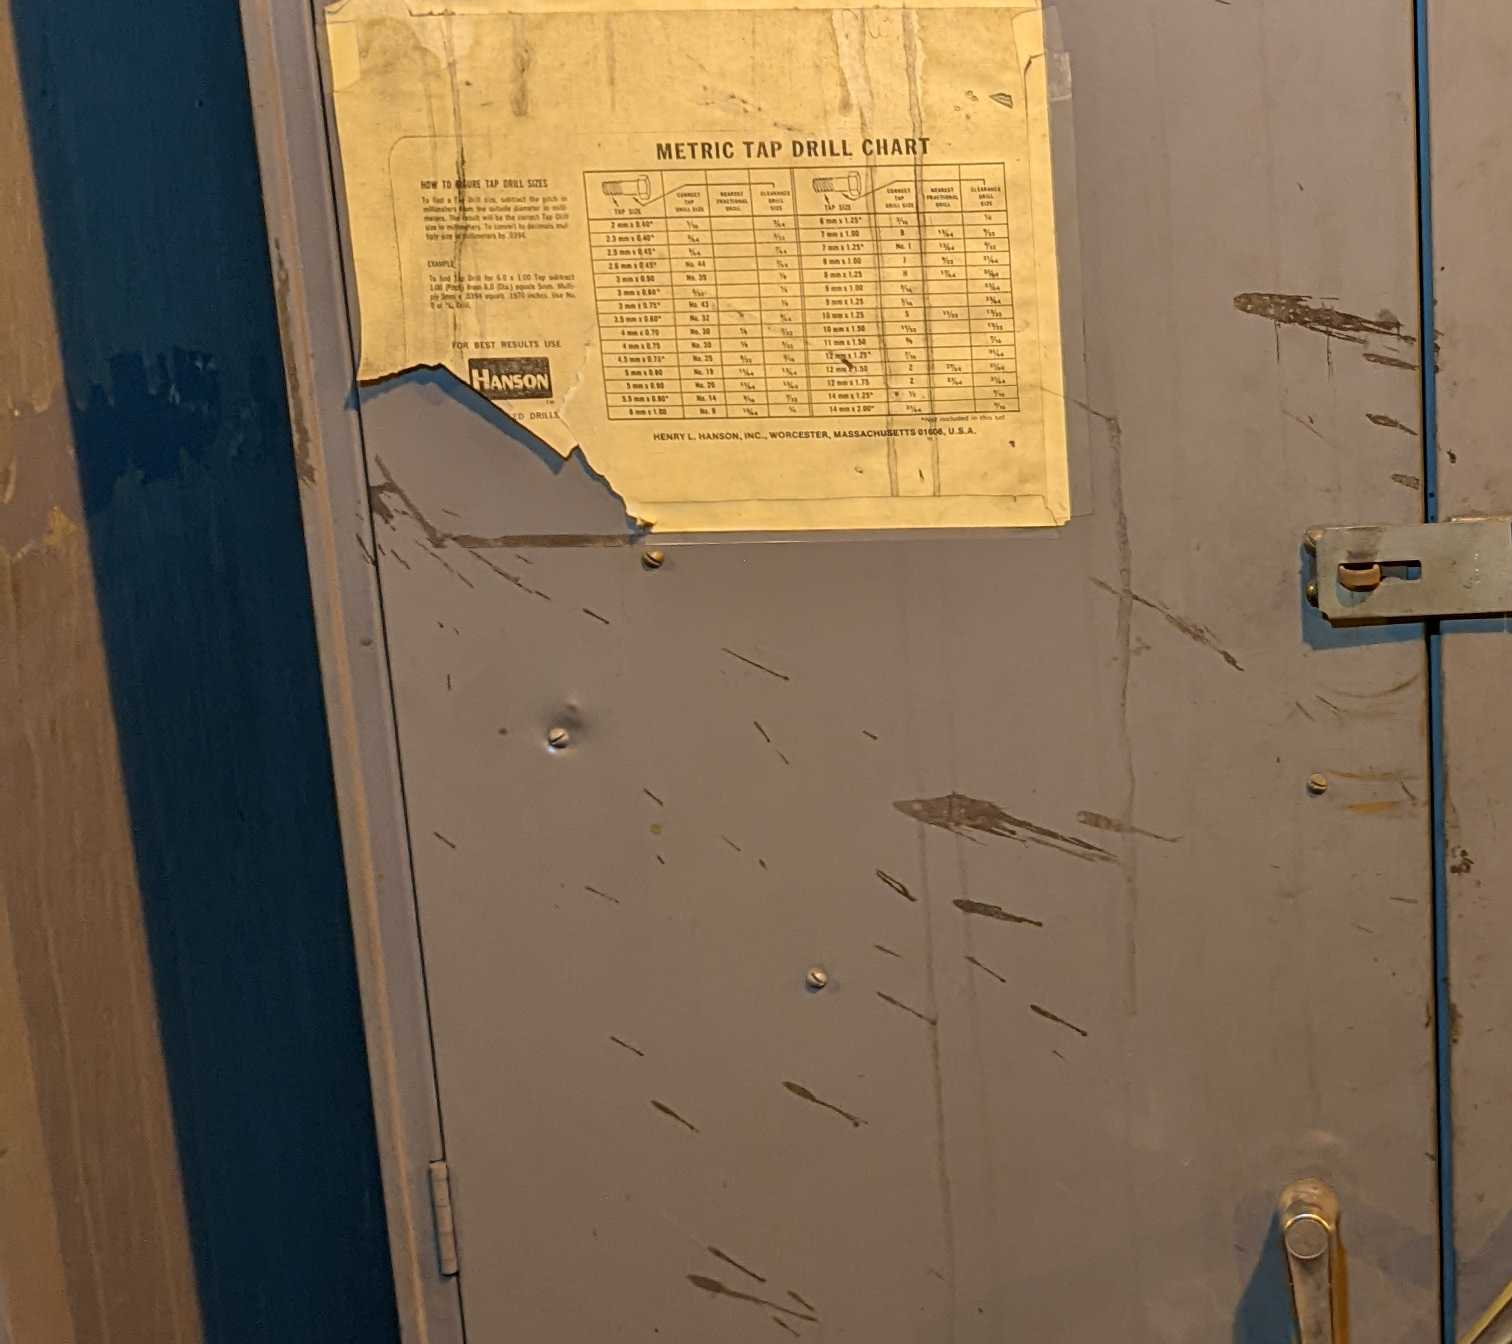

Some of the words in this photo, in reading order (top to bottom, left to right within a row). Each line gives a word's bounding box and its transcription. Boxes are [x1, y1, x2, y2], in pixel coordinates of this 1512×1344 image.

[656, 141, 735, 160] METRIC
[742, 140, 782, 159] TAP
[792, 139, 853, 158] DRILL
[861, 138, 930, 156] CHART
[442, 180, 452, 189] TO
[486, 180, 499, 188] TAP
[503, 180, 524, 188] DRILL
[528, 179, 548, 188] SIZES
[530, 412, 560, 420] DRILLS
[653, 432, 685, 440] HENRY
[688, 432, 696, 440] L.
[698, 432, 743, 441] HANSON,
[769, 431, 831, 440] WORCESTER,
[833, 429, 916, 438] MASSACHUSETTS
